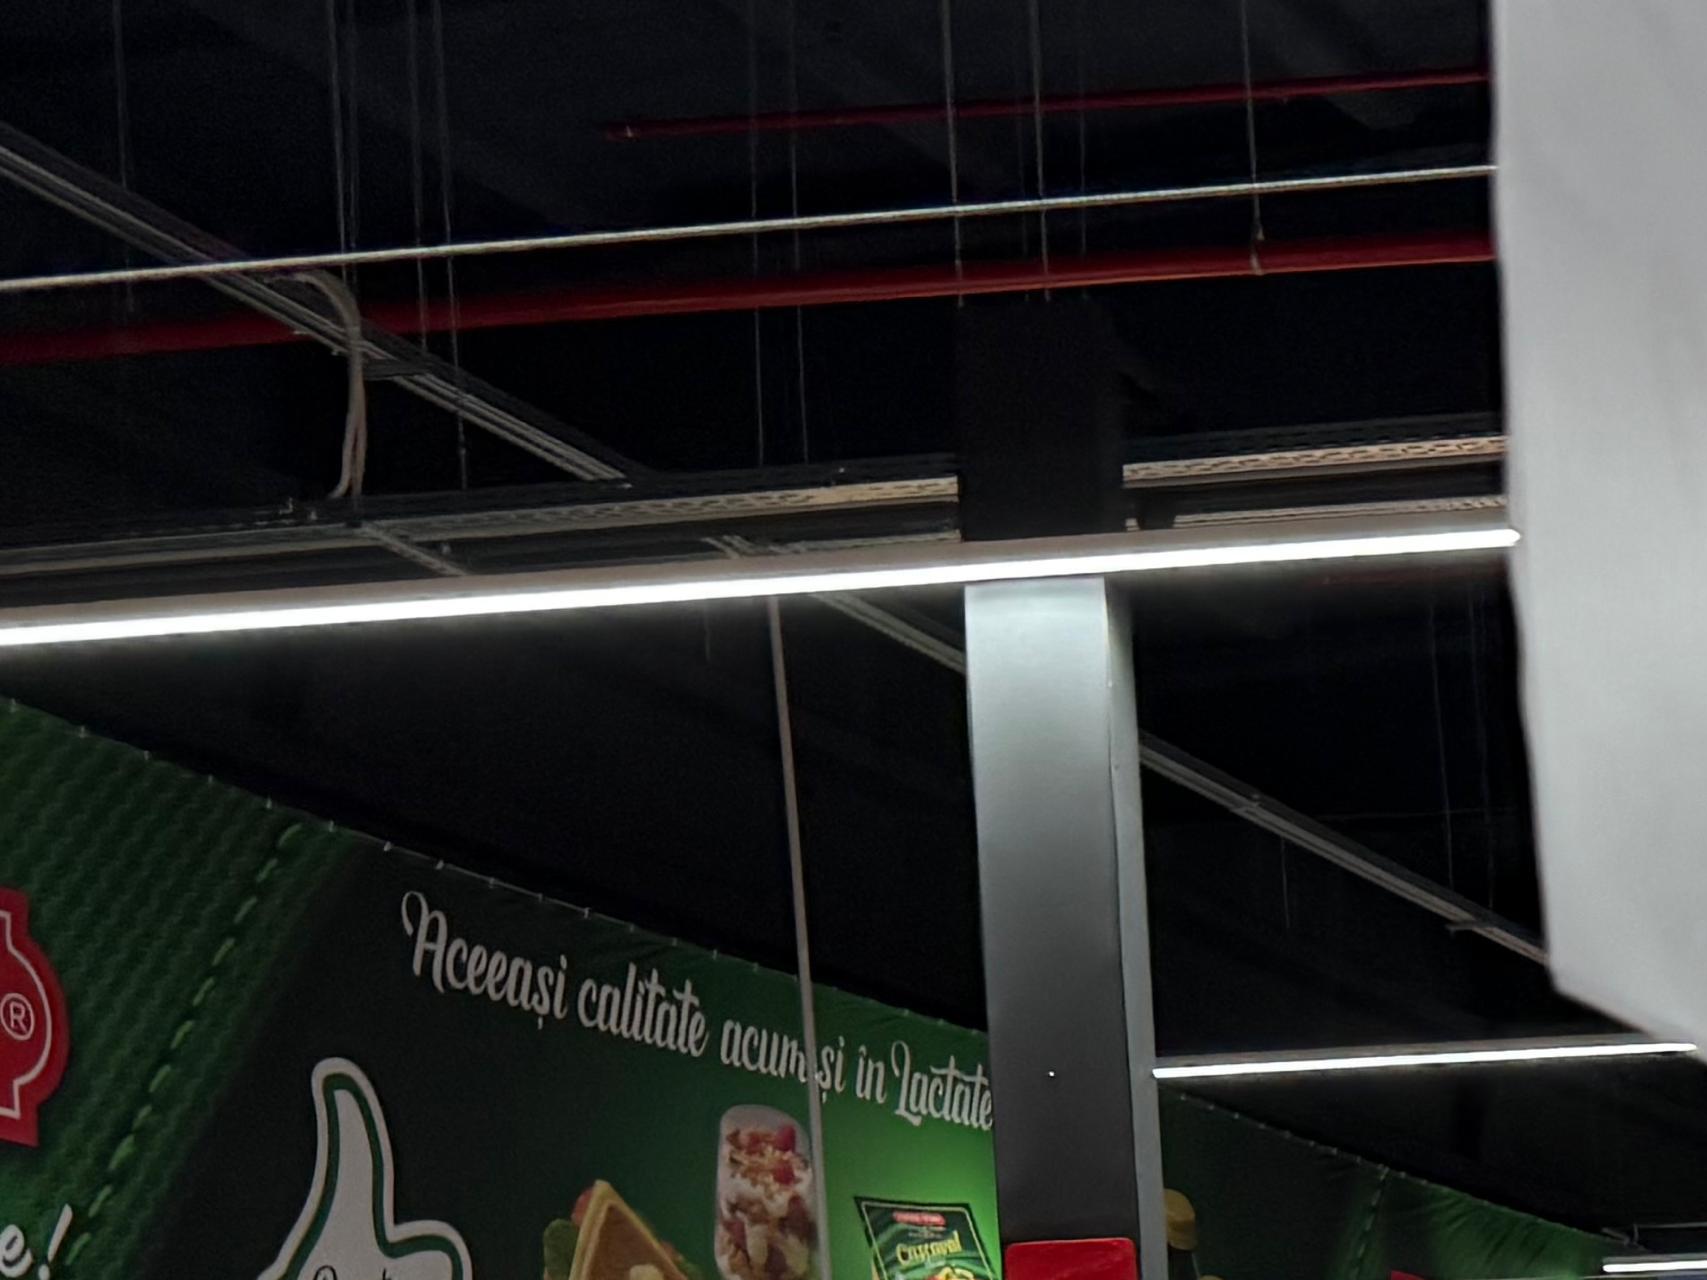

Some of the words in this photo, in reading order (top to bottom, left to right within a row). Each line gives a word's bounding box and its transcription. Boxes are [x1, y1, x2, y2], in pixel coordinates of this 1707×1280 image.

[401, 891, 568, 1029] Aceeași
[577, 962, 709, 1057] calitate
[720, 1019, 808, 1083] acum
[855, 1044, 887, 1105] în
[891, 1040, 993, 1131] Lactate
